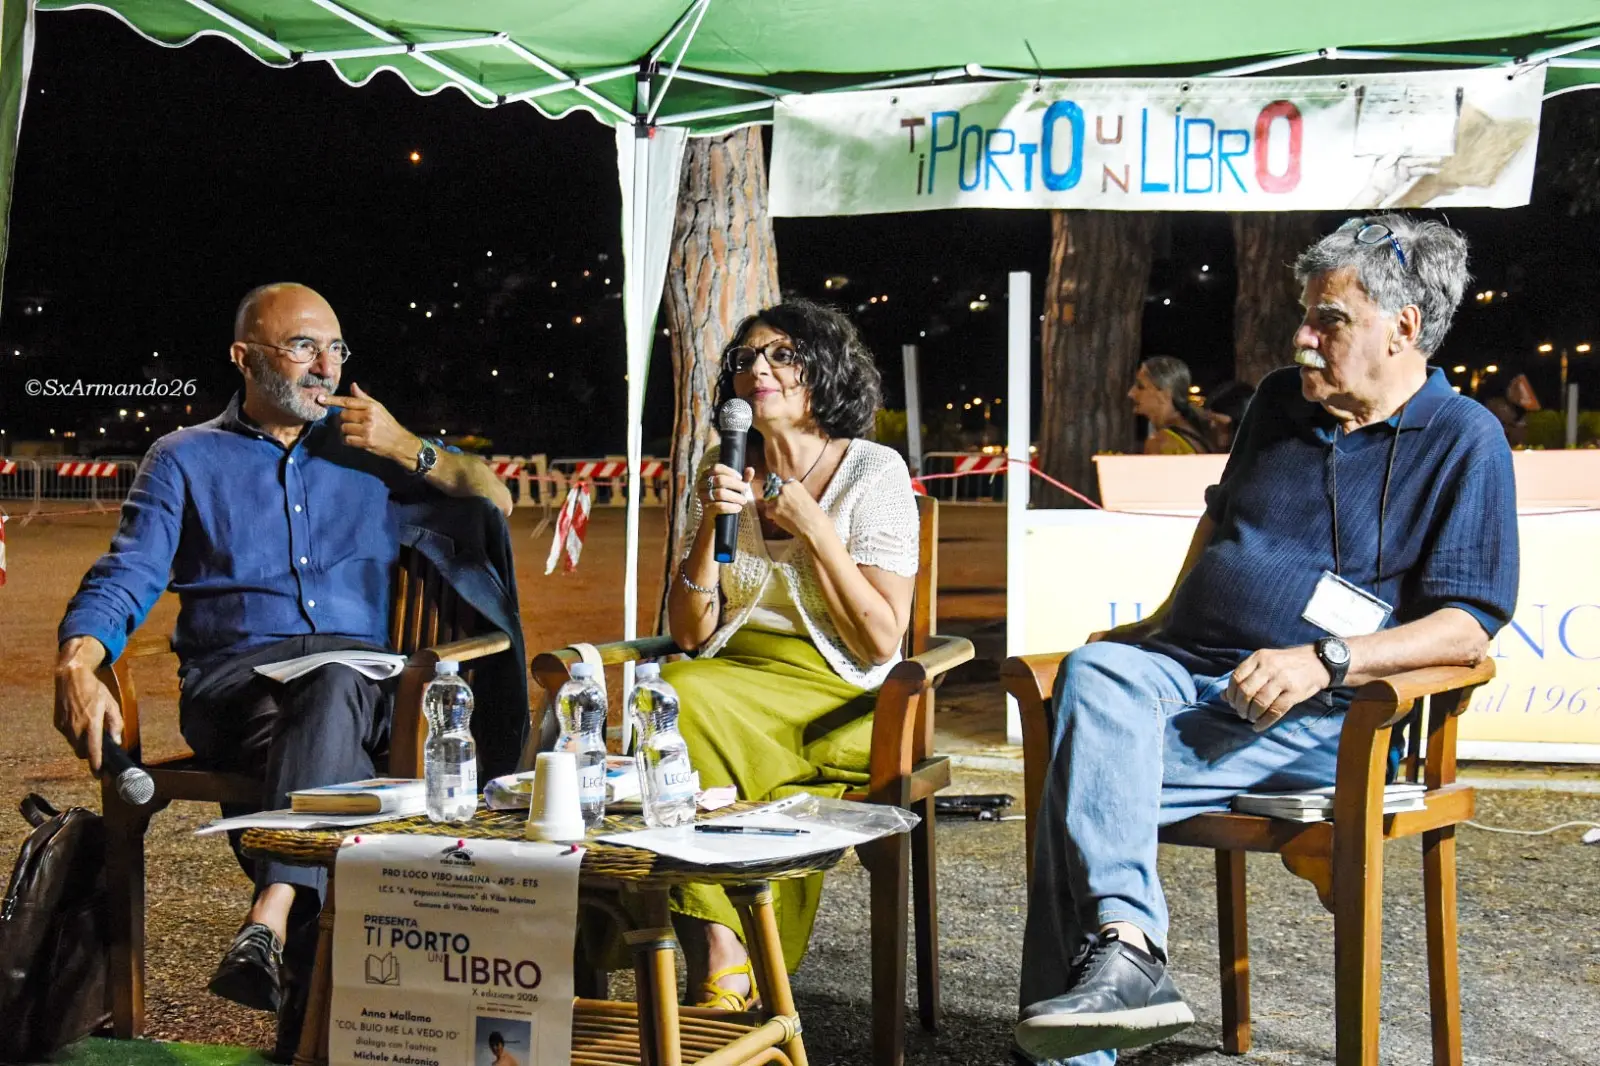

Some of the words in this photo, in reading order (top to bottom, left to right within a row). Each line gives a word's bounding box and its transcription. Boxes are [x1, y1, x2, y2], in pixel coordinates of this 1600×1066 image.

[927, 99, 1085, 195] PORTO
[1096, 115, 1130, 194] UN
[382, 868, 400, 878] PRO
[403, 869, 428, 879] LOCO
[431, 871, 452, 881] VIBO
[455, 874, 490, 884] MARINA
[498, 876, 515, 886] APS
[523, 878, 539, 888] ETS
[413, 900, 441, 909] Comune
[443, 902, 450, 910] di
[452, 903, 468, 911] Vibo
[490, 894, 507, 902] Vibo
[364, 914, 418, 929] PRESENTA
[364, 926, 381, 947] TI
[391, 930, 470, 954] PORTO
[427, 952, 443, 964] UN
[443, 955, 542, 990] LIBRO
[472, 988, 478, 997] X
[481, 988, 514, 999] edizione
[516, 993, 539, 1002] 2026
[360, 1008, 386, 1019] Anna
[389, 1010, 432, 1023] Mallamo
[360, 1022, 382, 1033] BUIO
[385, 1025, 399, 1035] ME
[401, 1026, 414, 1036] LA
[416, 1028, 444, 1039] VEDO
[388, 1041, 403, 1049] con
[353, 1051, 389, 1062] Michele
[392, 1054, 440, 1066] Andronico
